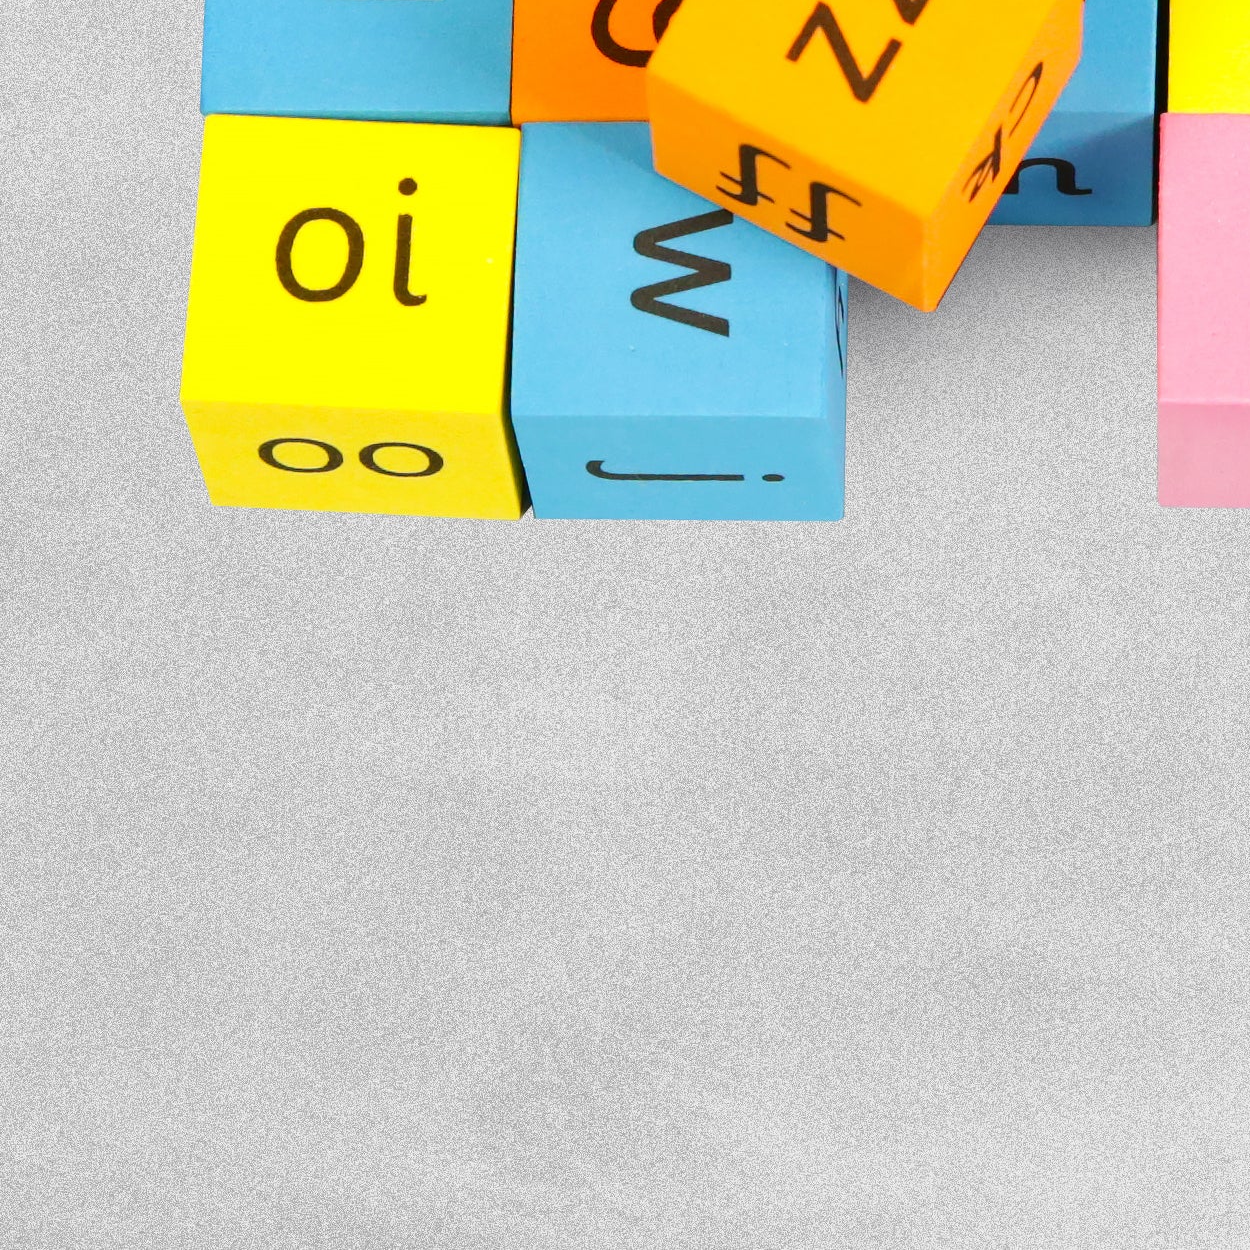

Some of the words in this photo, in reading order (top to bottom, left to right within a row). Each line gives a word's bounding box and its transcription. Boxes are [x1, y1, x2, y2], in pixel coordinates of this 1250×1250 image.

[276, 177, 428, 308] oi
[716, 143, 862, 244] ff
[630, 208, 734, 338] w
[258, 438, 444, 477] oo
